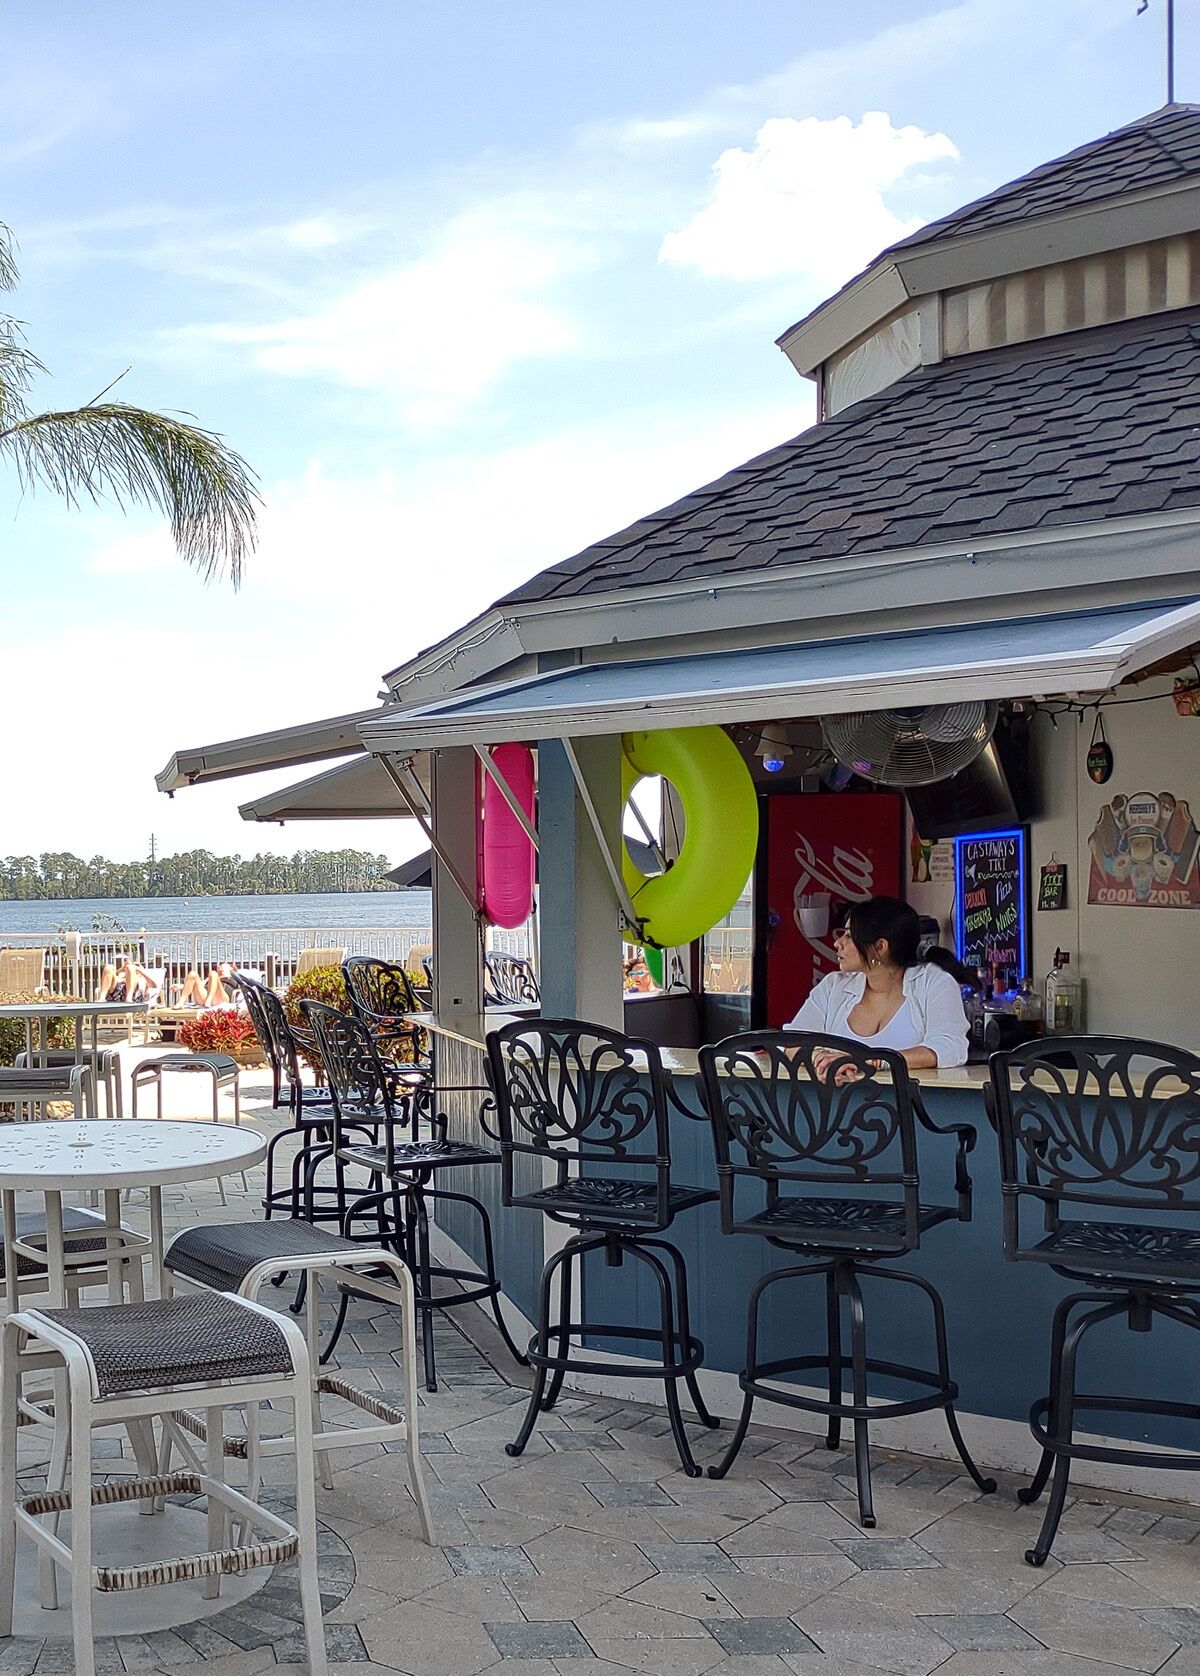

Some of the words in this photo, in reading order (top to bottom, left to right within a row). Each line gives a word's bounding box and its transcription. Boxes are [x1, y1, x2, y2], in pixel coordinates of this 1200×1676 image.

[967, 839, 1015, 860] CASTAWAYS
[1098, 887, 1136, 903] COOL
[1147, 889, 1191, 904] ZONE
